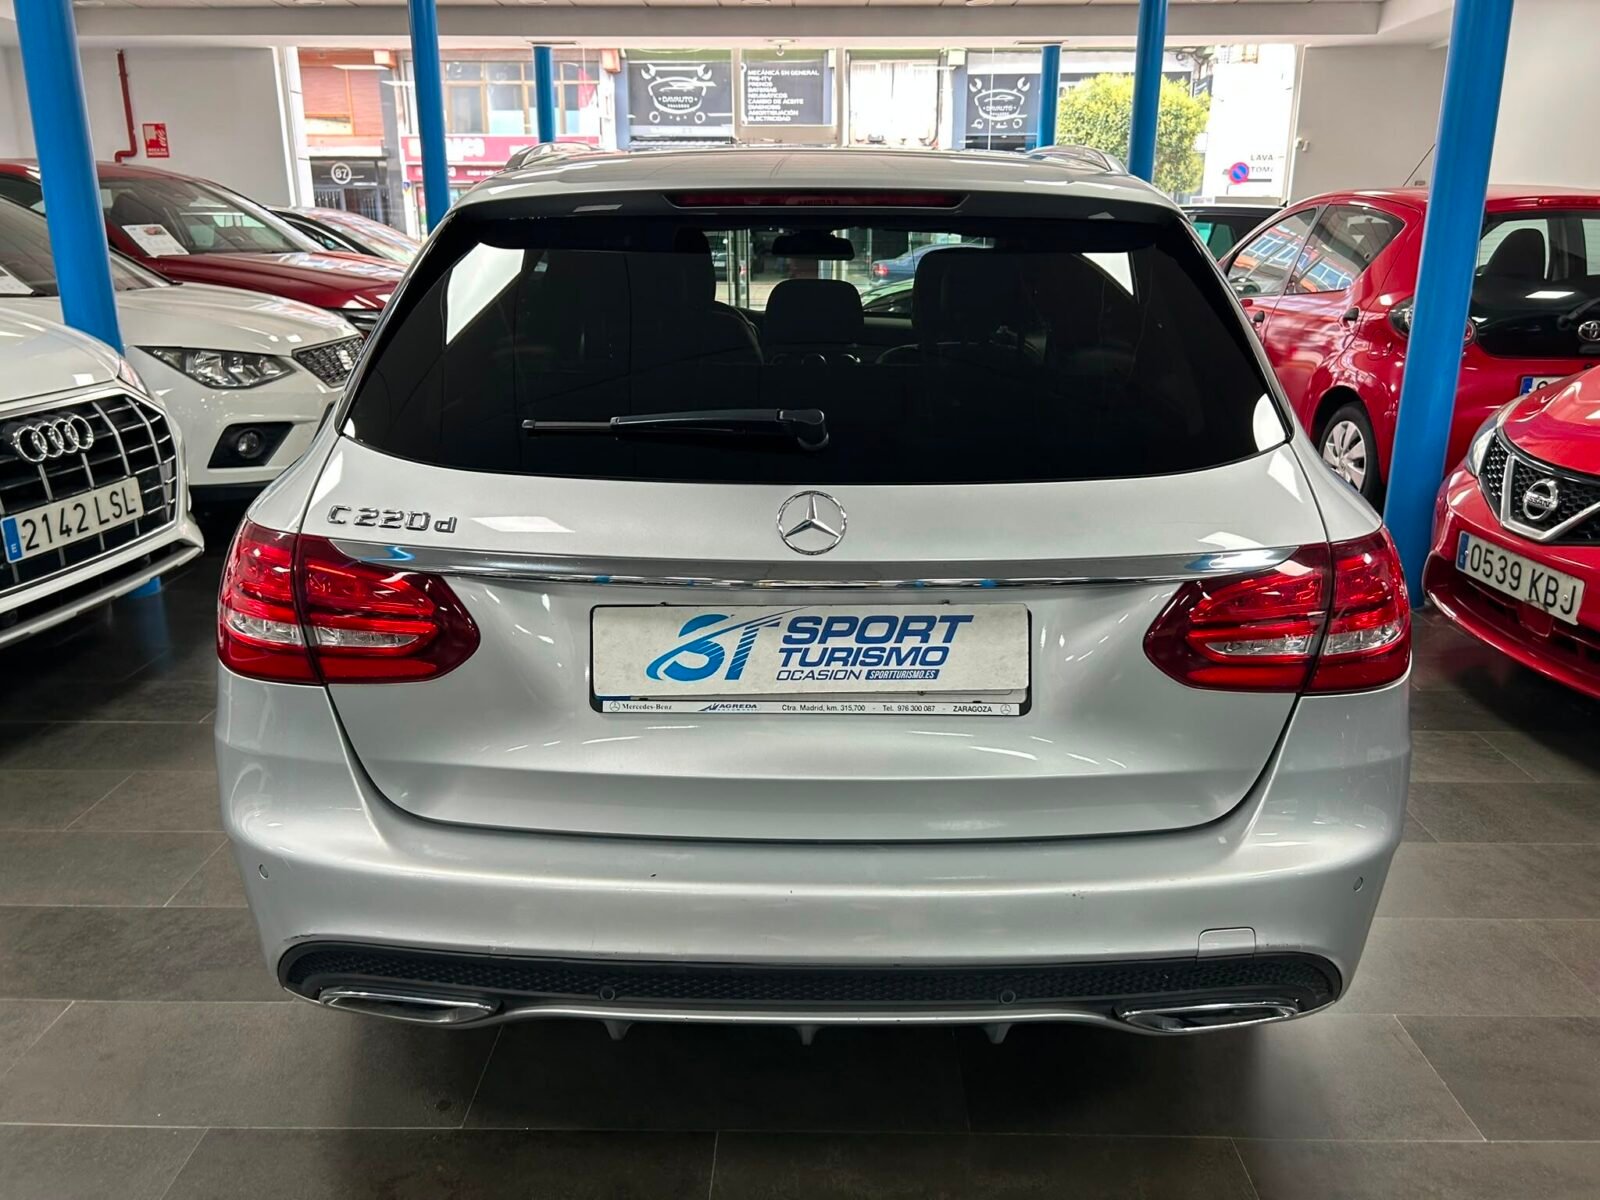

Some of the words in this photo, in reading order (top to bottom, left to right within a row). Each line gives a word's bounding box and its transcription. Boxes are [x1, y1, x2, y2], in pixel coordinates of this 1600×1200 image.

[21, 502, 90, 552] 2142
[94, 487, 137, 526] LSL
[326, 504, 352, 525] C
[353, 506, 432, 532] 220
[433, 516, 458, 534] d
[1469, 543, 1522, 592] 0539
[1527, 567, 1577, 615] KBJ
[781, 614, 975, 646] SPORT
[777, 645, 951, 668] TURISMO
[775, 668, 863, 682] OCASION
[867, 669, 937, 681] SPORTTURISMO.ES
[621, 702, 673, 711] Mercedes-Benz
[910, 704, 923, 713] 300
[952, 705, 993, 713] ZARAGOZA
